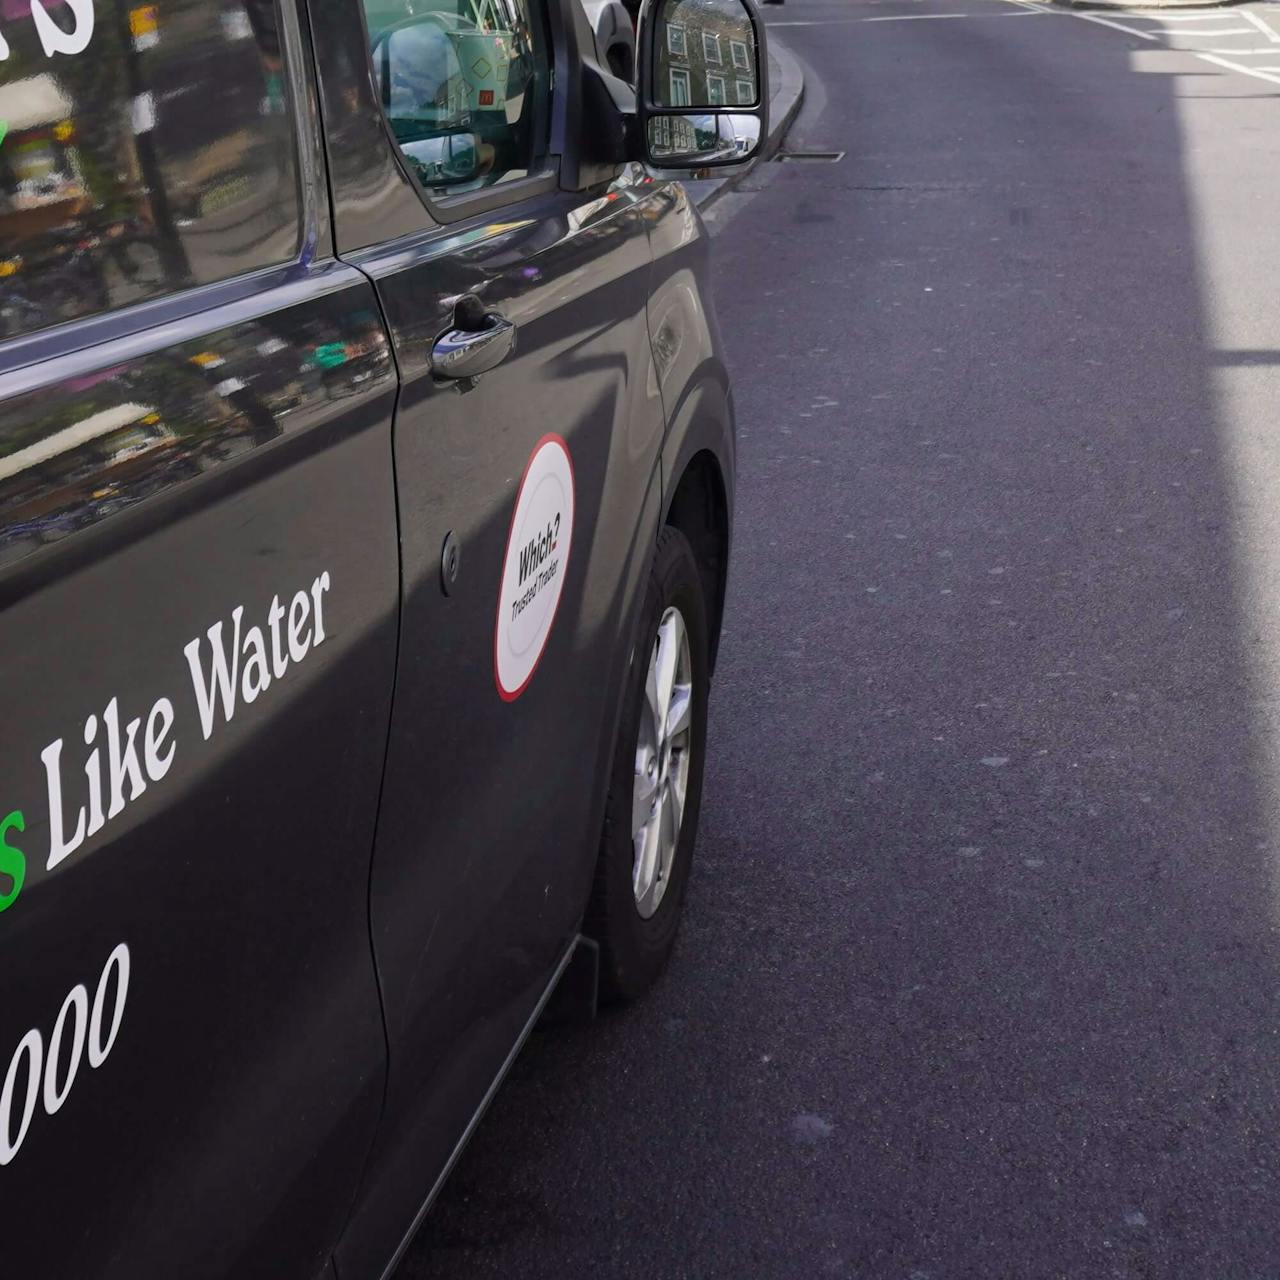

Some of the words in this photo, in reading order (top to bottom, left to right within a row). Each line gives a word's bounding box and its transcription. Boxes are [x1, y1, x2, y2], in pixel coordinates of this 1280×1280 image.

[519, 512, 561, 586] Which?
[511, 582, 538, 622] Trusted
[538, 559, 559, 590] Trader
[38, 697, 177, 872] Like
[183, 570, 332, 742] Water
